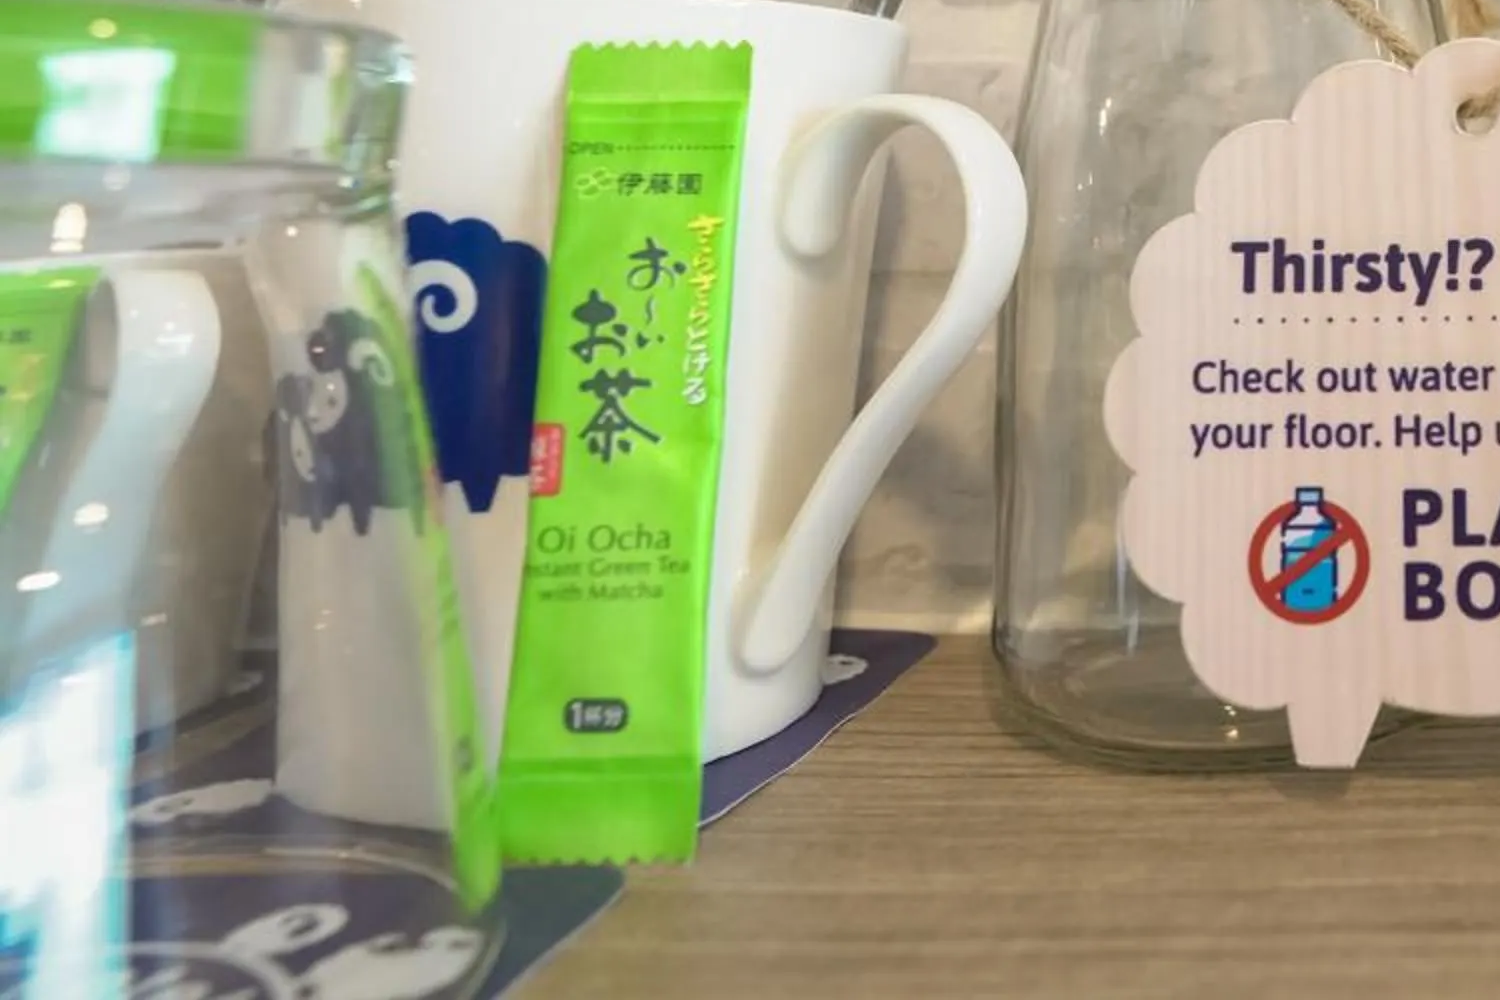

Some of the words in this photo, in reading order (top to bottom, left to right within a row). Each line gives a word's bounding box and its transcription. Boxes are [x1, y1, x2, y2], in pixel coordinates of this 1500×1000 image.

[1229, 237, 1495, 308] Thirsty!?
[1192, 358, 1306, 395] Check
[1316, 361, 1378, 394] out
[1387, 361, 1496, 393] water
[1189, 423, 1274, 459] your
[1283, 412, 1383, 450] floor.
[1394, 411, 1483, 457] Help
[536, 525, 577, 554] Oi
[587, 522, 673, 553] Ocha
[524, 562, 582, 578] nstant
[587, 557, 652, 577] Green
[657, 554, 692, 574] Tea
[537, 579, 582, 602] with
[587, 579, 665, 601] Matcha
